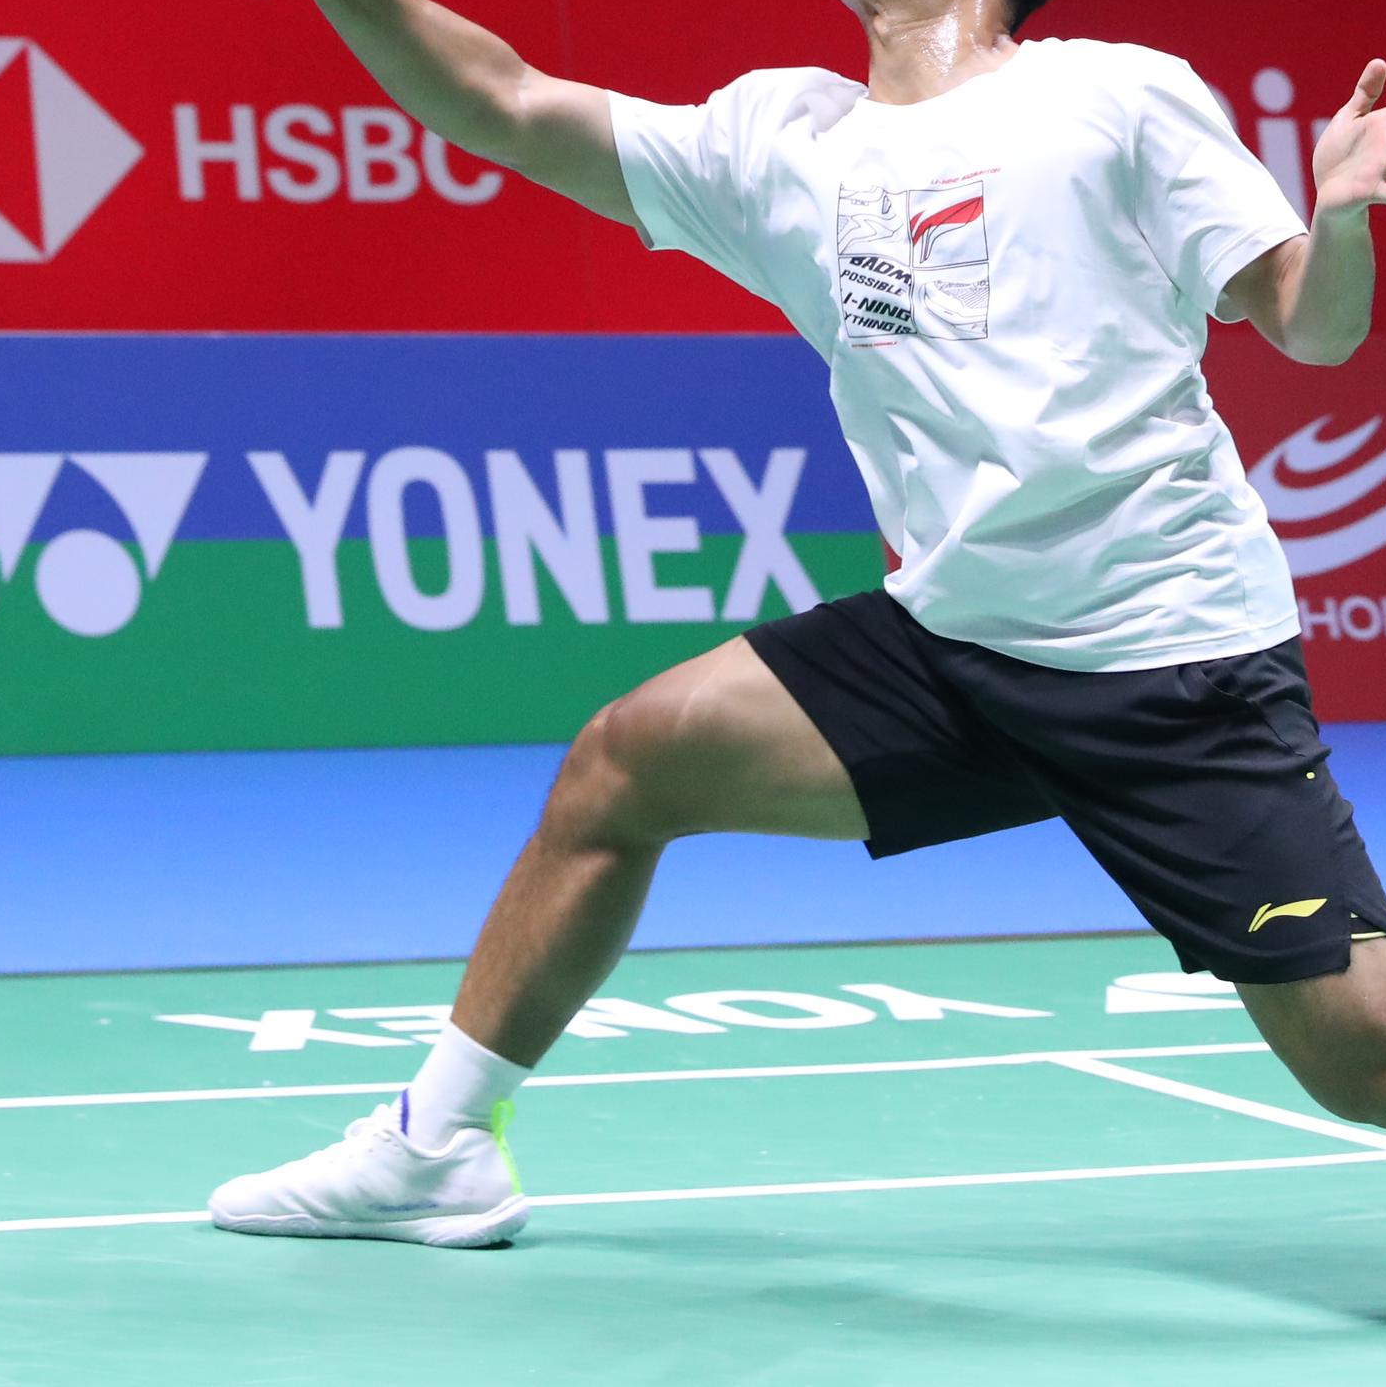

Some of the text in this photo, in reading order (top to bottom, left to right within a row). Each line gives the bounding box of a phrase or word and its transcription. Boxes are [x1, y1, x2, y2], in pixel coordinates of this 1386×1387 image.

[171, 103, 503, 206] HSBC
[840, 269, 907, 297] POSSIBLE
[849, 256, 913, 287] BADM
[843, 292, 912, 322] I-NING
[844, 311, 896, 332] YTHING
[246, 445, 819, 631] YONEX
